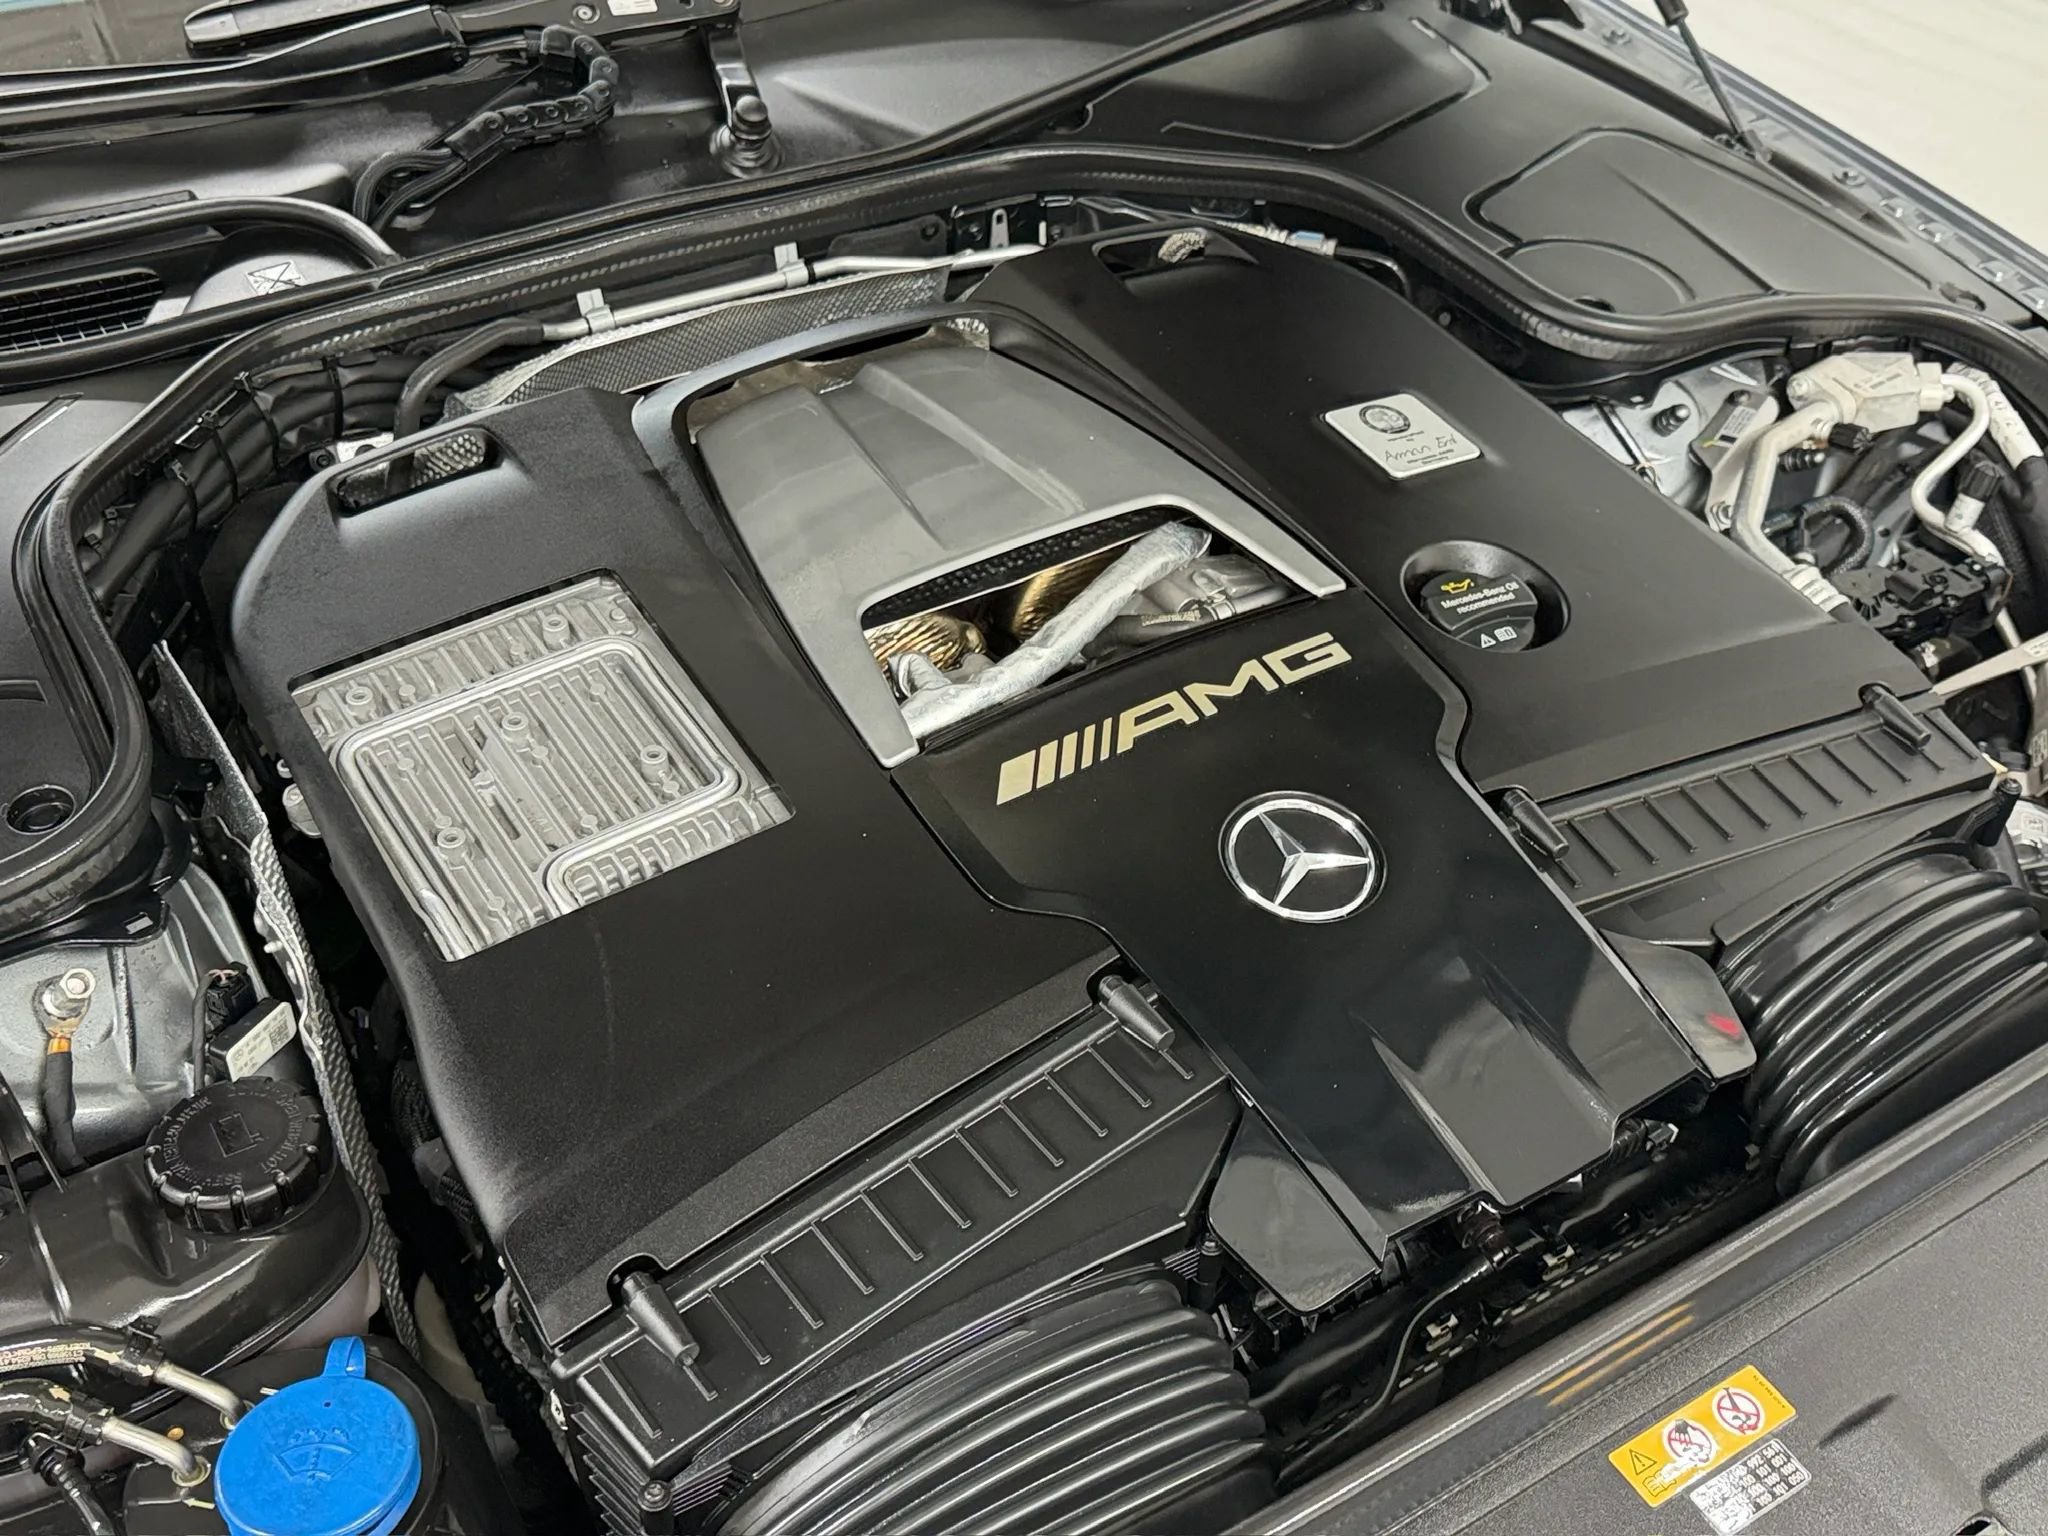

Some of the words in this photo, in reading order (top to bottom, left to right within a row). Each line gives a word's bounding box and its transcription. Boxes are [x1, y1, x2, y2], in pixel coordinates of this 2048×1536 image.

[1441, 585, 1506, 609] Mercedes-Benz
[1456, 592, 1516, 614] recommended
[1117, 632, 1352, 753] AMG
